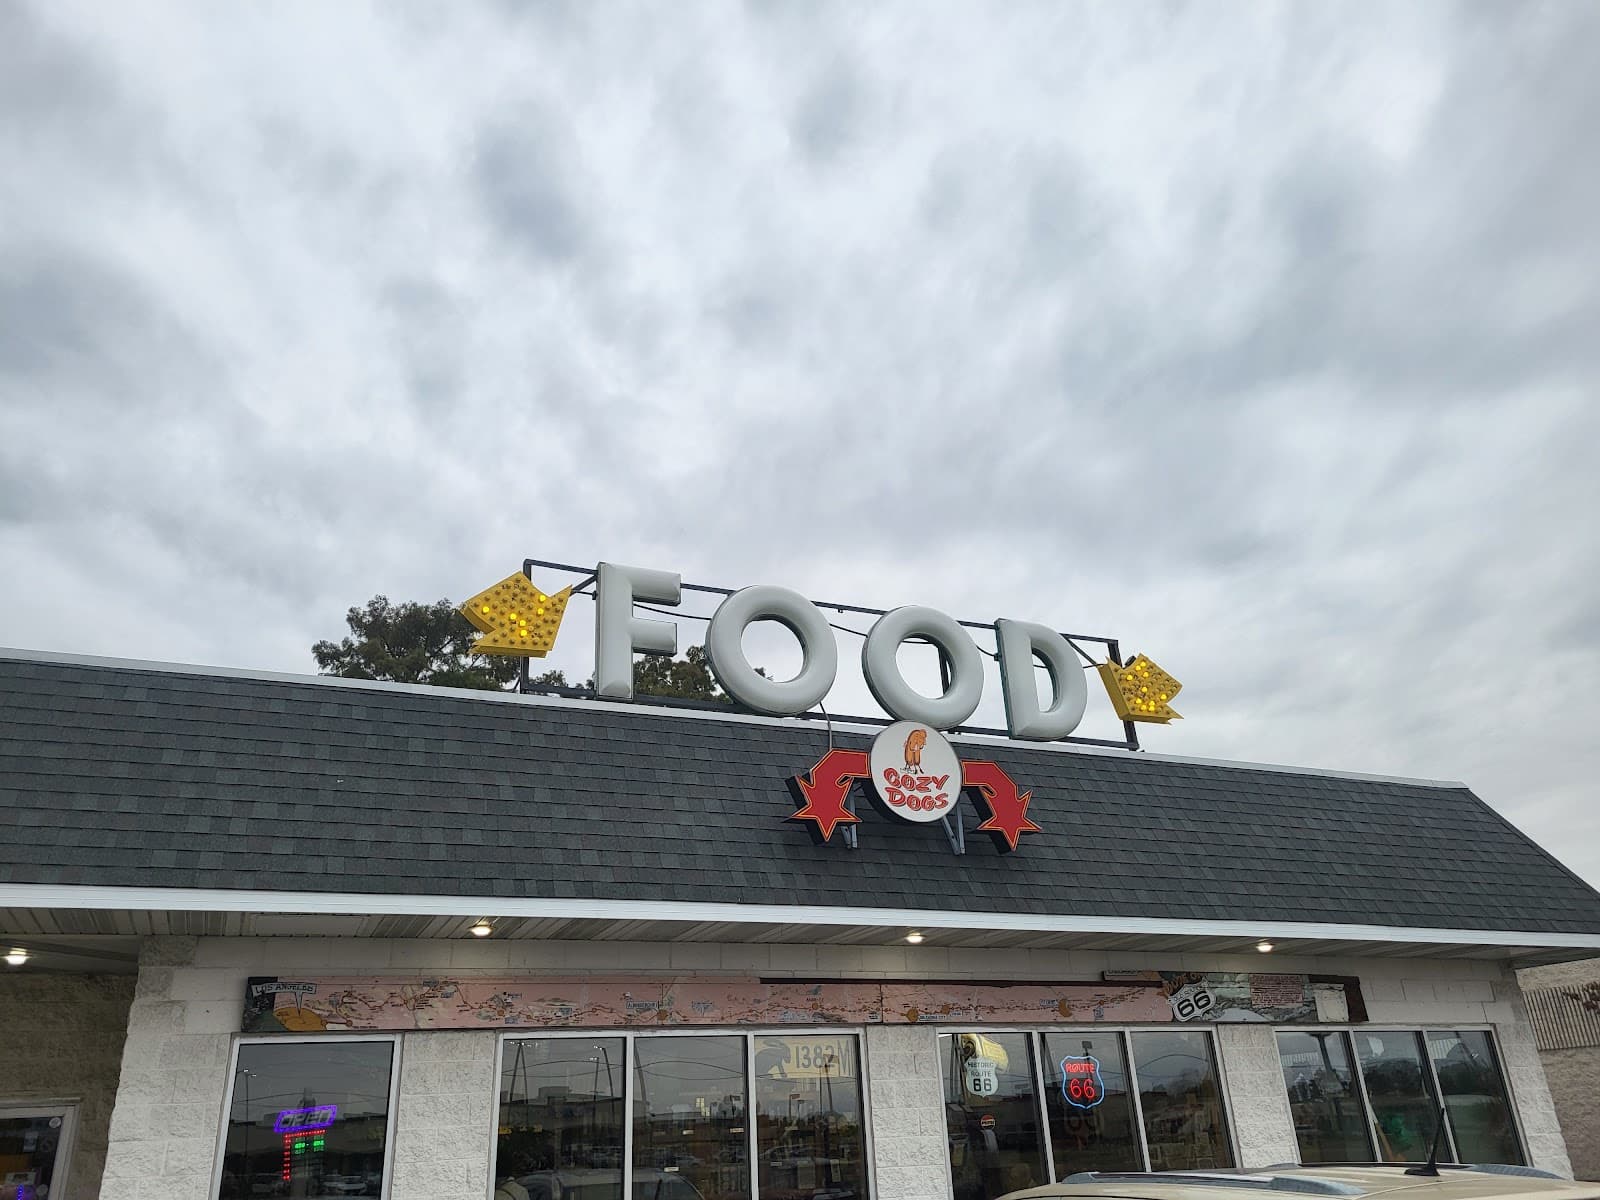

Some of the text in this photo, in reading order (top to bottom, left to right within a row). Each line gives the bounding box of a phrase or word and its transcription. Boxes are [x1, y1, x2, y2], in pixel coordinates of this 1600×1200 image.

[596, 562, 1087, 740] FOOD
[883, 767, 950, 793] COZY
[884, 786, 949, 811] DOGS
[255, 984, 273, 994] LOS
[1177, 990, 1212, 1018] 66
[1065, 1063, 1096, 1074] ROUTE
[973, 1078, 992, 1092] 66
[1070, 1078, 1096, 1099] 66
[280, 1109, 332, 1128] OPEN
